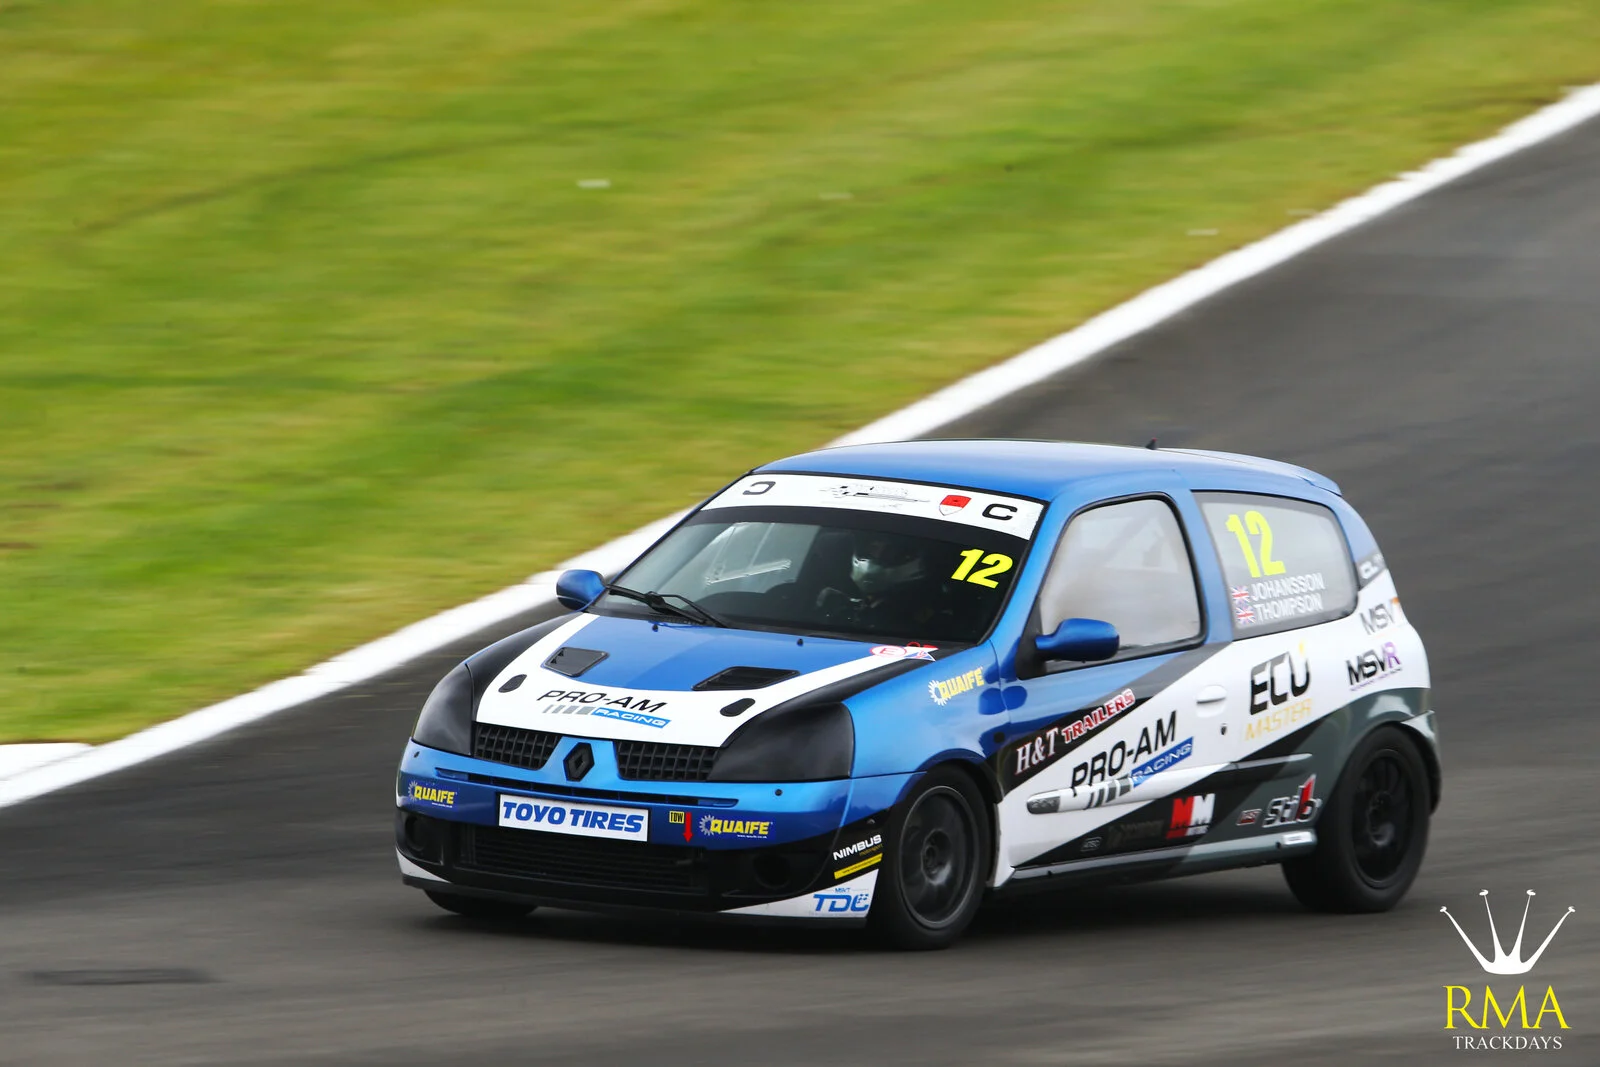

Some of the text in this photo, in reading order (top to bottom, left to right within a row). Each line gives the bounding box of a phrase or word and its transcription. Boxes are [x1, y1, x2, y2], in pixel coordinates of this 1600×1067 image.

[982, 503, 1018, 521] C
[1225, 510, 1286, 578] 12
[951, 548, 1013, 589] 12
[1251, 573, 1326, 601] JOHANSSON
[1254, 592, 1323, 622] THOMPSON
[1346, 641, 1401, 686] MSVR
[938, 666, 985, 700] QUAIFE
[1250, 651, 1310, 716] ECU
[536, 690, 668, 713] PRO-AM
[594, 708, 667, 727] RACING
[1015, 688, 1136, 775] H&T TRAILERS
[1245, 698, 1311, 740] MASTER
[1071, 710, 1177, 797] PRO-AM
[1131, 743, 1193, 782] RACING
[414, 785, 455, 805] QUAIFE
[503, 801, 645, 833] TOYO TIRES
[710, 819, 769, 835] QUAIFE
[832, 834, 882, 860] NIMBUS
[813, 893, 869, 912] TDC
